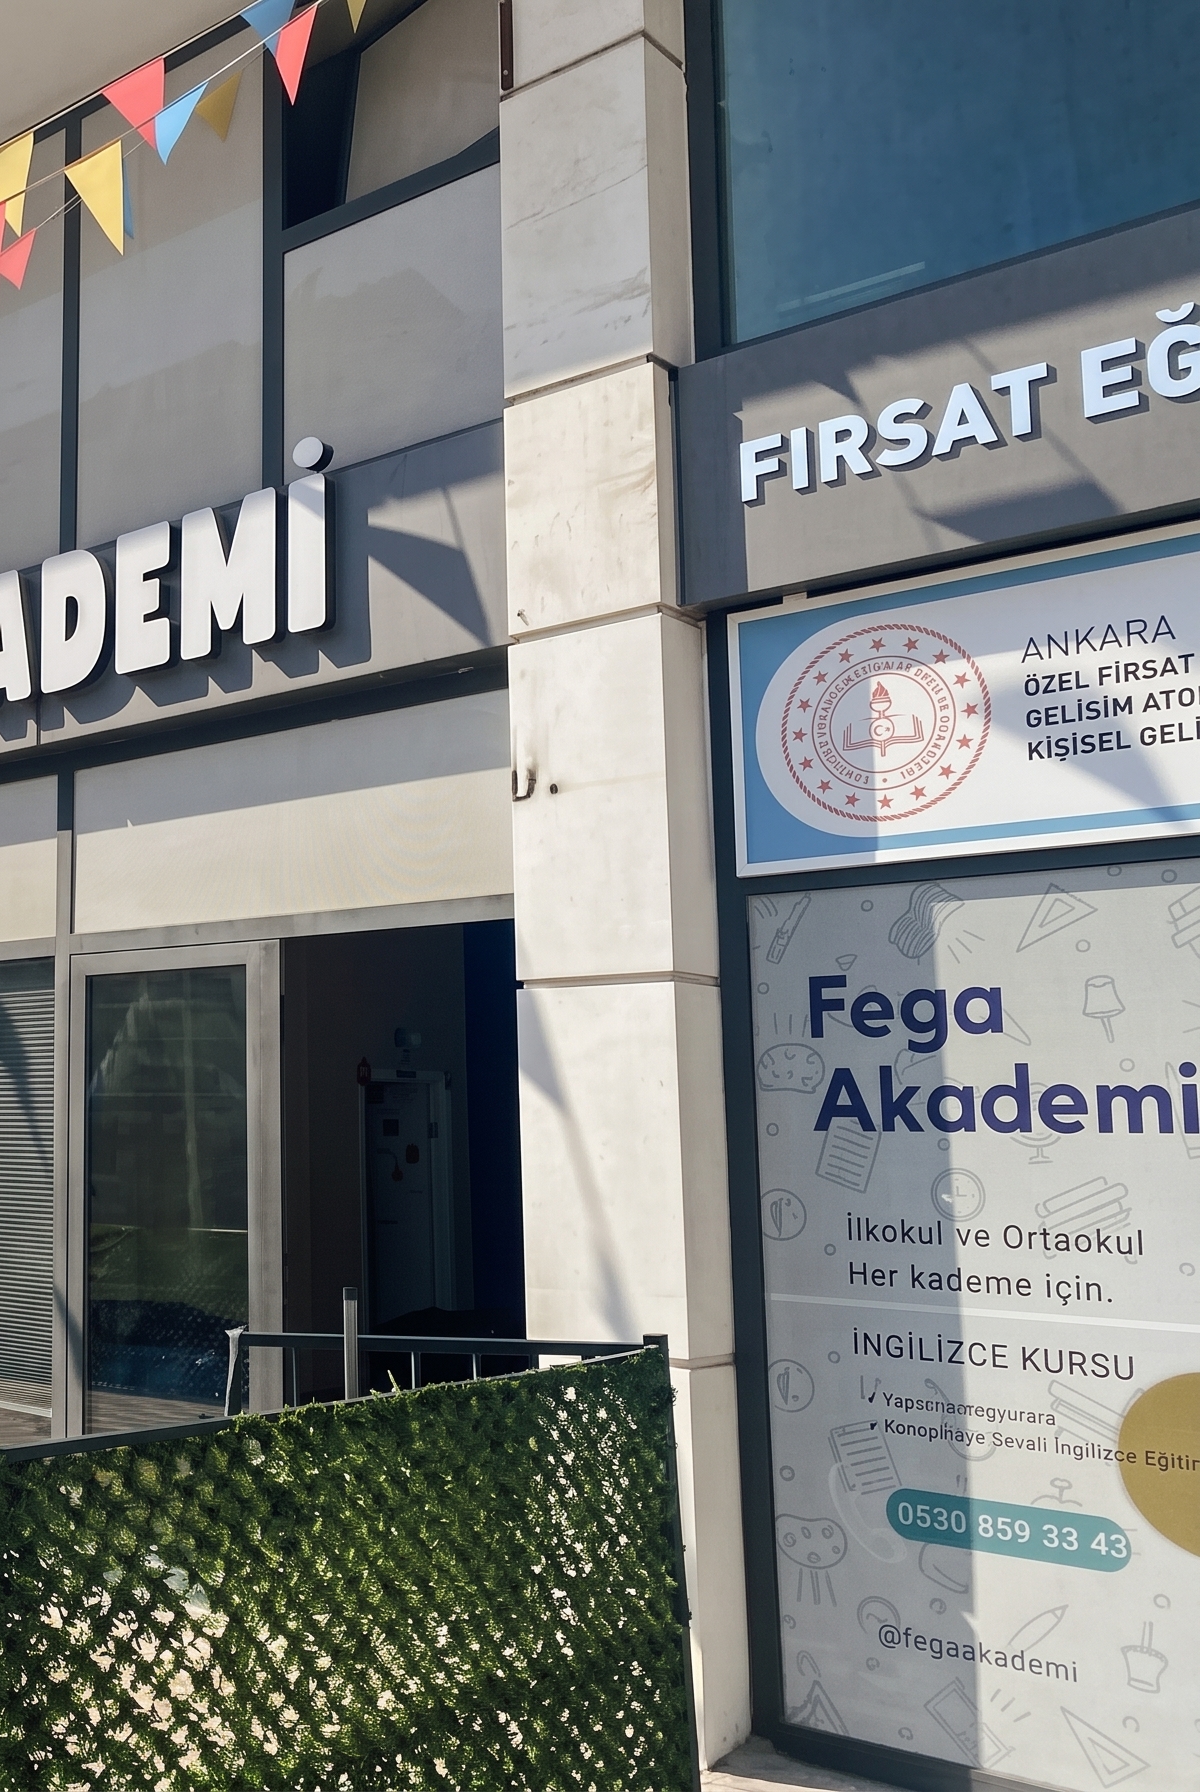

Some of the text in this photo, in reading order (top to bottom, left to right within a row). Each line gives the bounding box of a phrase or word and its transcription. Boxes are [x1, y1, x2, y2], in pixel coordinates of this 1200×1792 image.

[739, 302, 1200, 503] FIRSAT EĞ
[1021, 615, 1177, 663] ANKARA
[1024, 653, 1195, 696] ÖZEL FİRSAT
[1026, 685, 1200, 728] GELİSİM ATO
[1028, 730, 1131, 761] KİŞİSEL
[808, 975, 1004, 1053] Fega
[813, 1062, 1200, 1134] Akademi
[846, 1212, 1144, 1256] İlkokul ve Ortaokul
[849, 1262, 1114, 1306] Her kademe için.
[852, 1327, 1135, 1380] İNGİLİZCE KURSU
[992, 1432, 1048, 1453] Sevali
[898, 1502, 1128, 1559] 0530 859 33 43
[877, 1624, 1079, 1682] @fegaakademi
